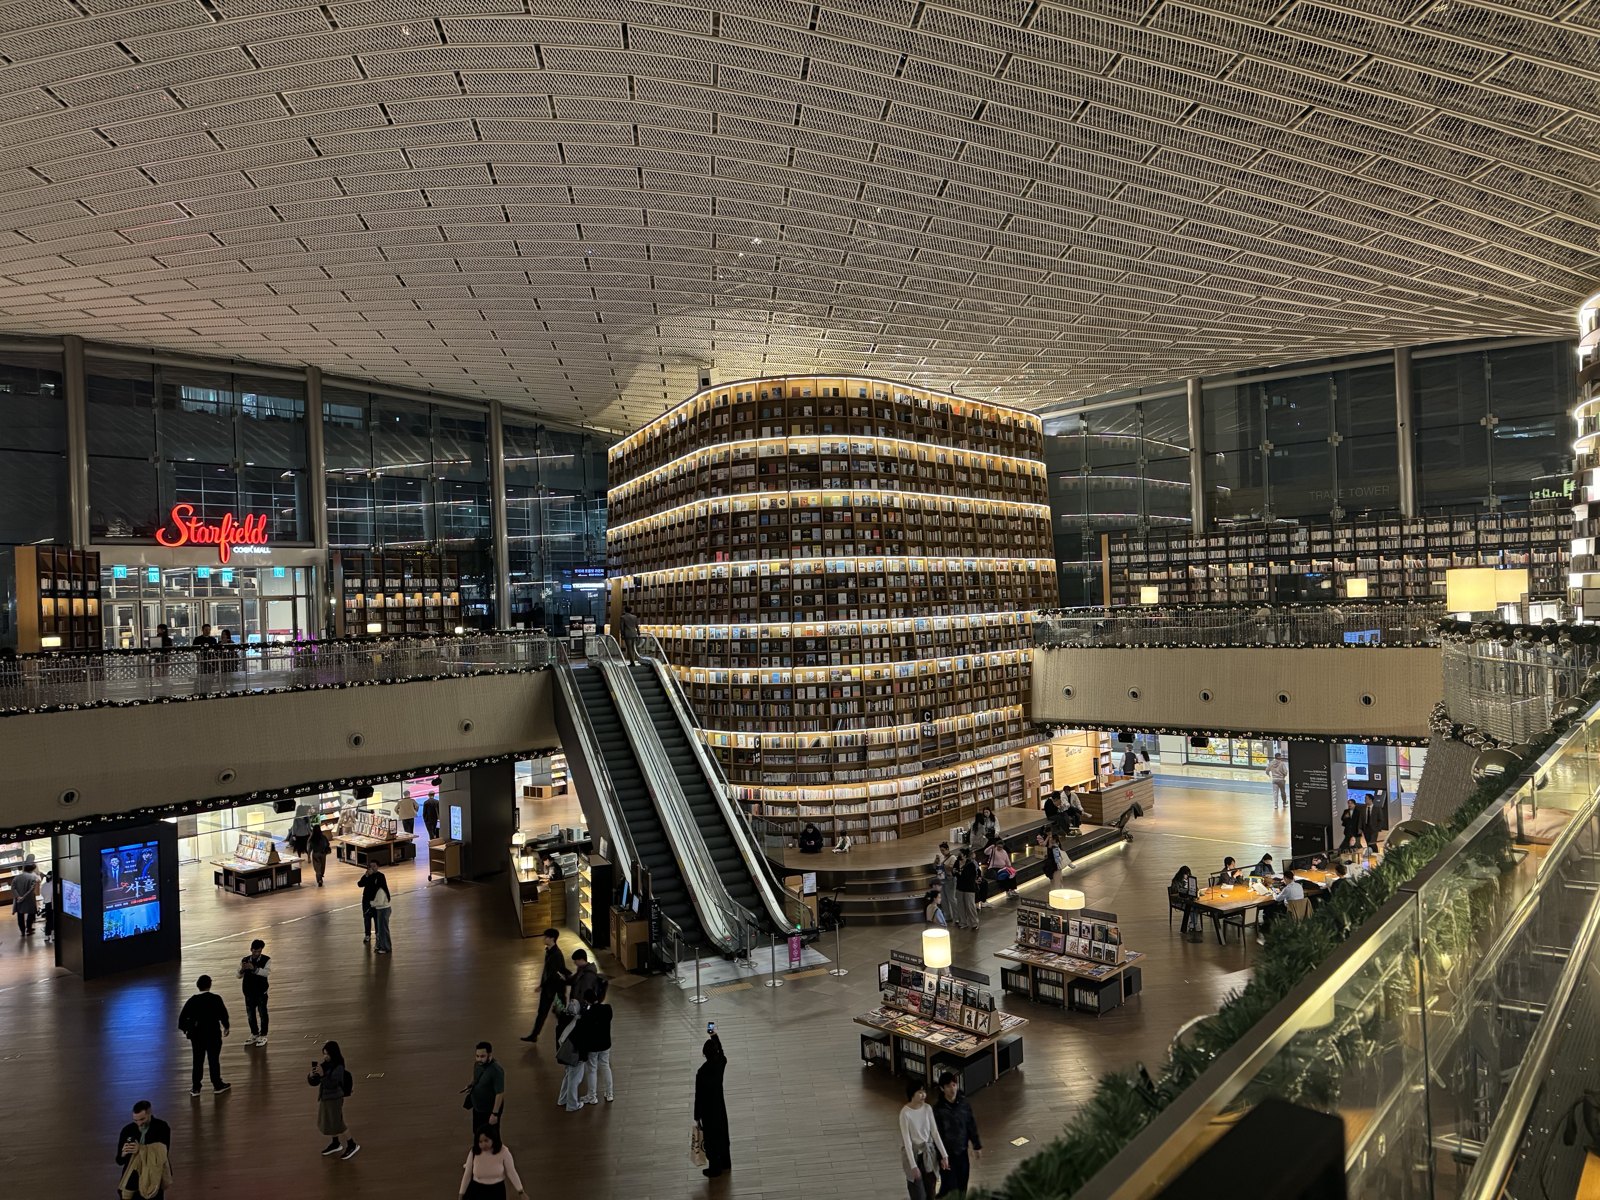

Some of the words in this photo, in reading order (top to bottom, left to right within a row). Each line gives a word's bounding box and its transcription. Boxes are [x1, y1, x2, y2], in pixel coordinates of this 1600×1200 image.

[1348, 485, 1390, 497] TOWER
[155, 503, 268, 564] Starfield
[254, 546, 272, 554] MALL
[924, 711, 931, 722] C
